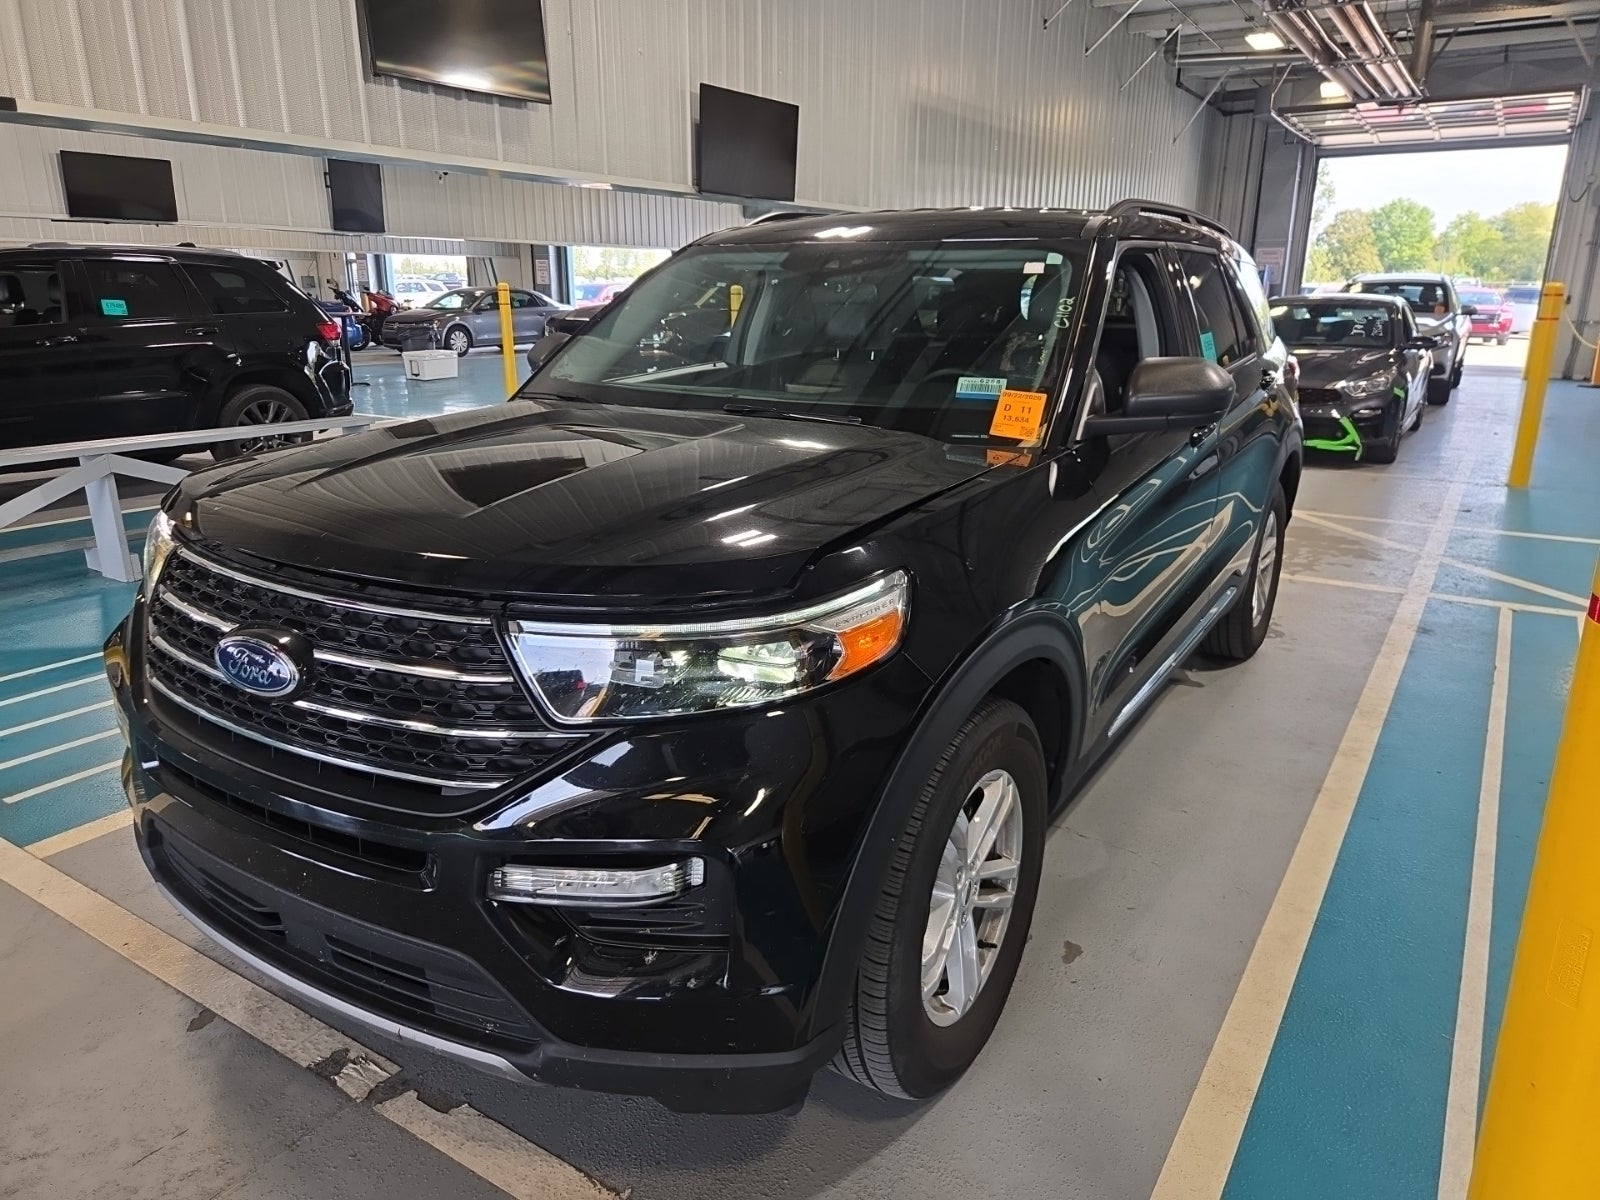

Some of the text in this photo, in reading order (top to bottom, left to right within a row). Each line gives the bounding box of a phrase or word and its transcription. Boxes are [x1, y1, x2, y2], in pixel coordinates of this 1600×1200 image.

[1003, 403, 1033, 415] D 11
[226, 645, 272, 685] Ford
